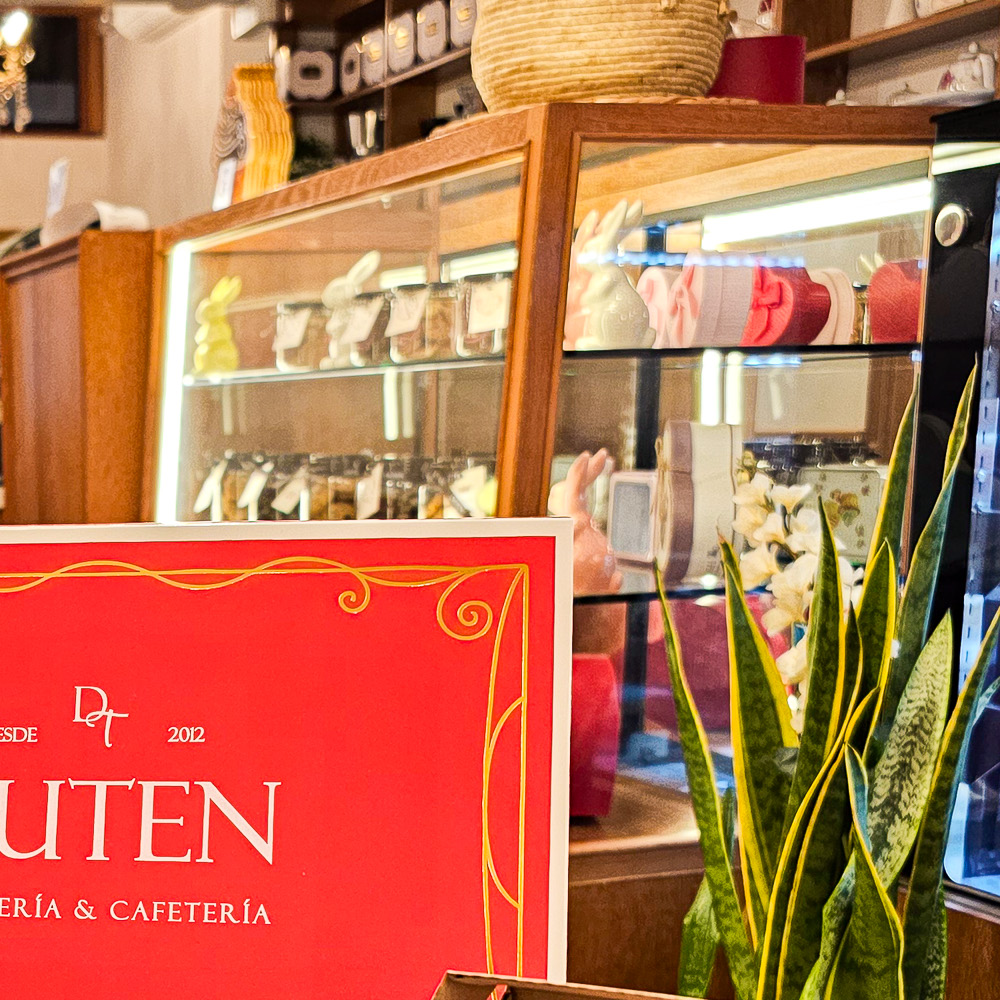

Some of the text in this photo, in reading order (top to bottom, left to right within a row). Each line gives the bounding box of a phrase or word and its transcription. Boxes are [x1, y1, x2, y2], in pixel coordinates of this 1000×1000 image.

[167, 726, 205, 743] 2012
[73, 899, 97, 920] &
[110, 899, 271, 925] CAFETERÍA
